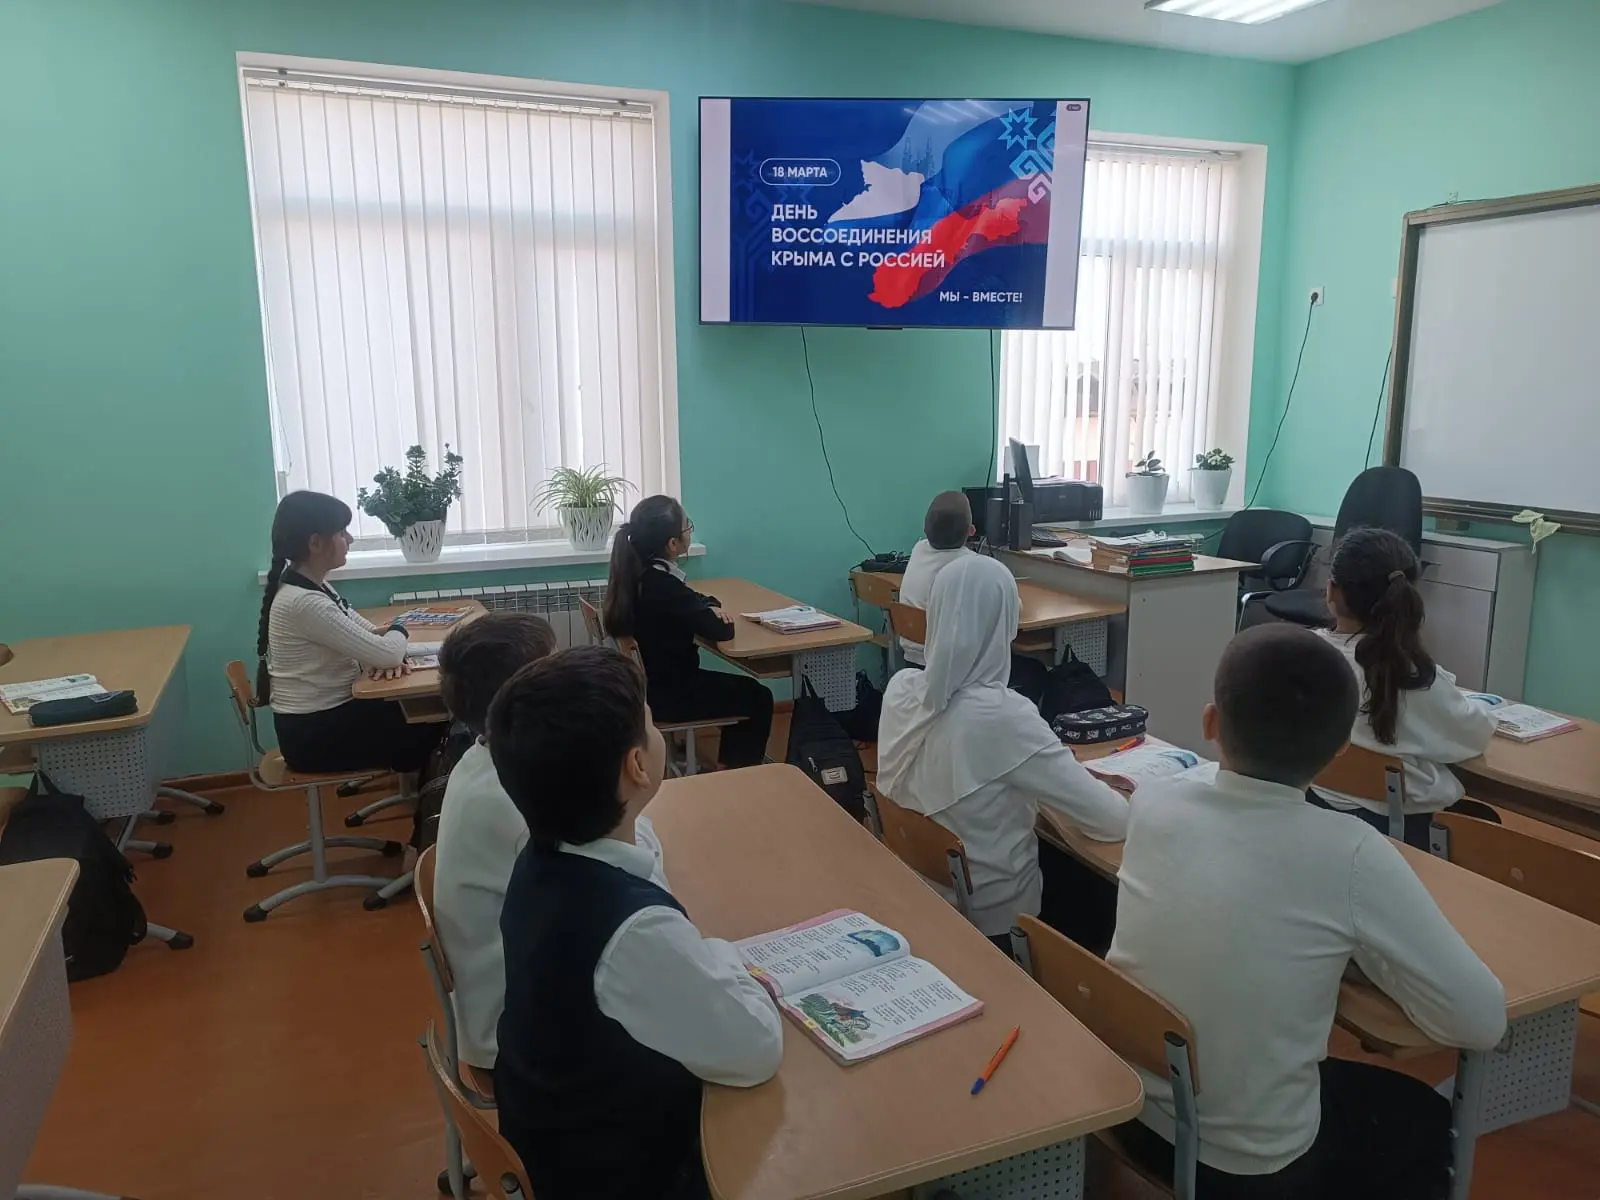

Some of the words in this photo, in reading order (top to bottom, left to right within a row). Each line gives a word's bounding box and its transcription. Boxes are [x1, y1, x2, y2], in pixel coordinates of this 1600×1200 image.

[772, 166, 784, 178] 18
[787, 166, 828, 178] МАРТА
[771, 204, 818, 222] ДЕНЬ
[771, 228, 932, 246] ВОССОЕДИНЕНИЯ
[771, 251, 836, 267] КРЫМА
[840, 251, 854, 267] С
[858, 250, 945, 268] РОССИЕЙ
[939, 291, 960, 302] МЫ
[972, 291, 1023, 303] ВМЕСТЕ!
